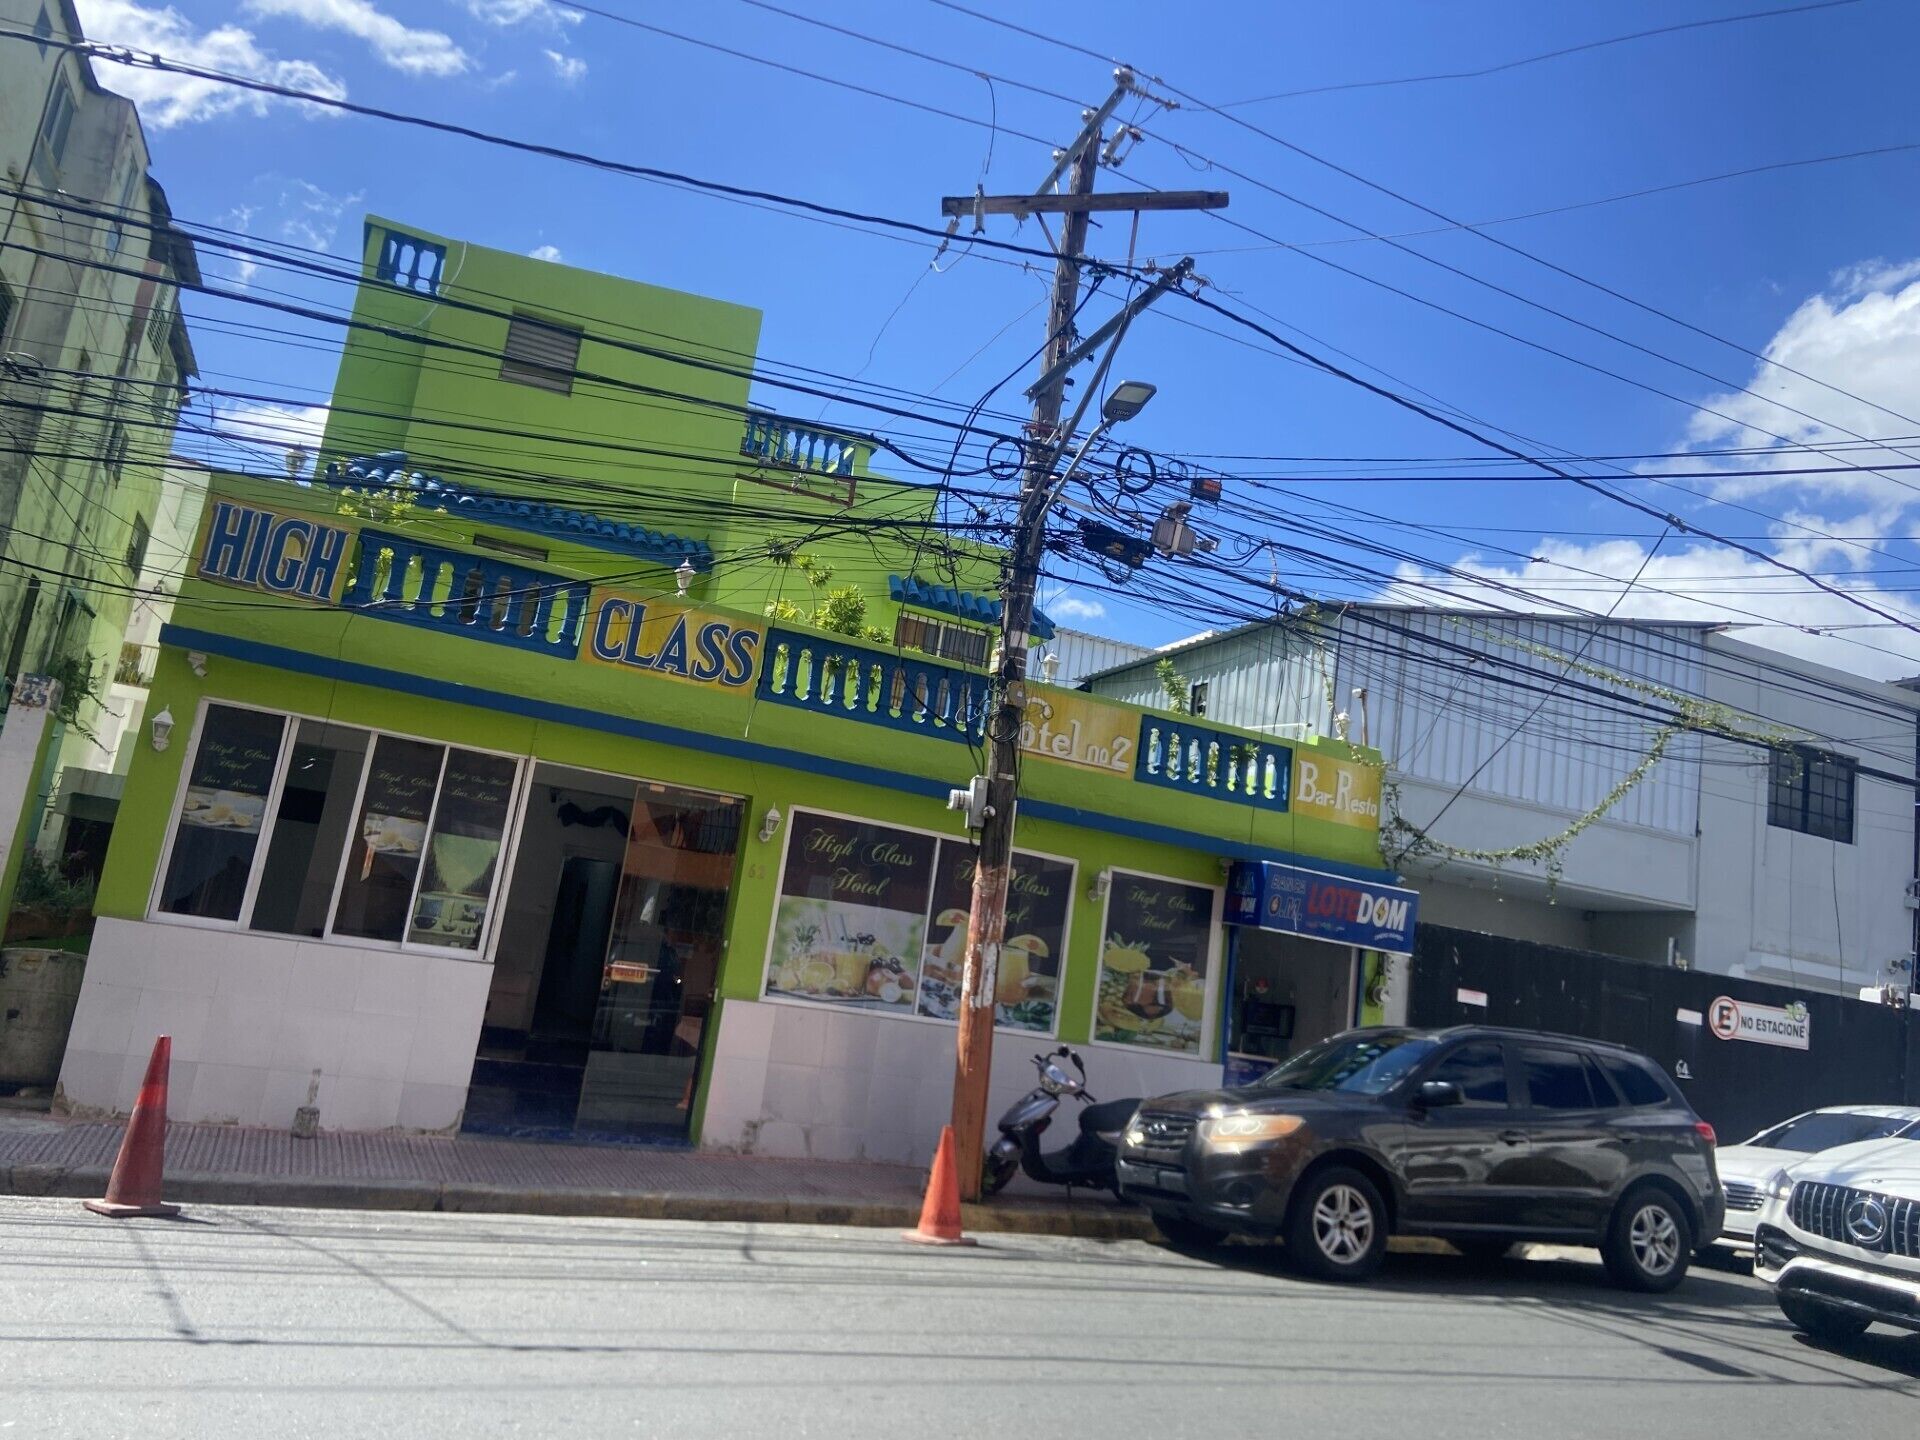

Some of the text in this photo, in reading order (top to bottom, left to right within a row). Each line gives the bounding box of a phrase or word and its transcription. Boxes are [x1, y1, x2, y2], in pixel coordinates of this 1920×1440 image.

[200, 501, 350, 600] HIGH
[592, 597, 760, 686] CLASS
[1018, 697, 1081, 759] otel
[803, 828, 917, 867] High Class
[829, 866, 891, 897] Hotel
[1013, 873, 1050, 897] Class
[1128, 885, 1196, 912] High Class
[1139, 911, 1178, 931] Hotel
[1740, 1016, 1806, 1039] NO ESTACIONE
